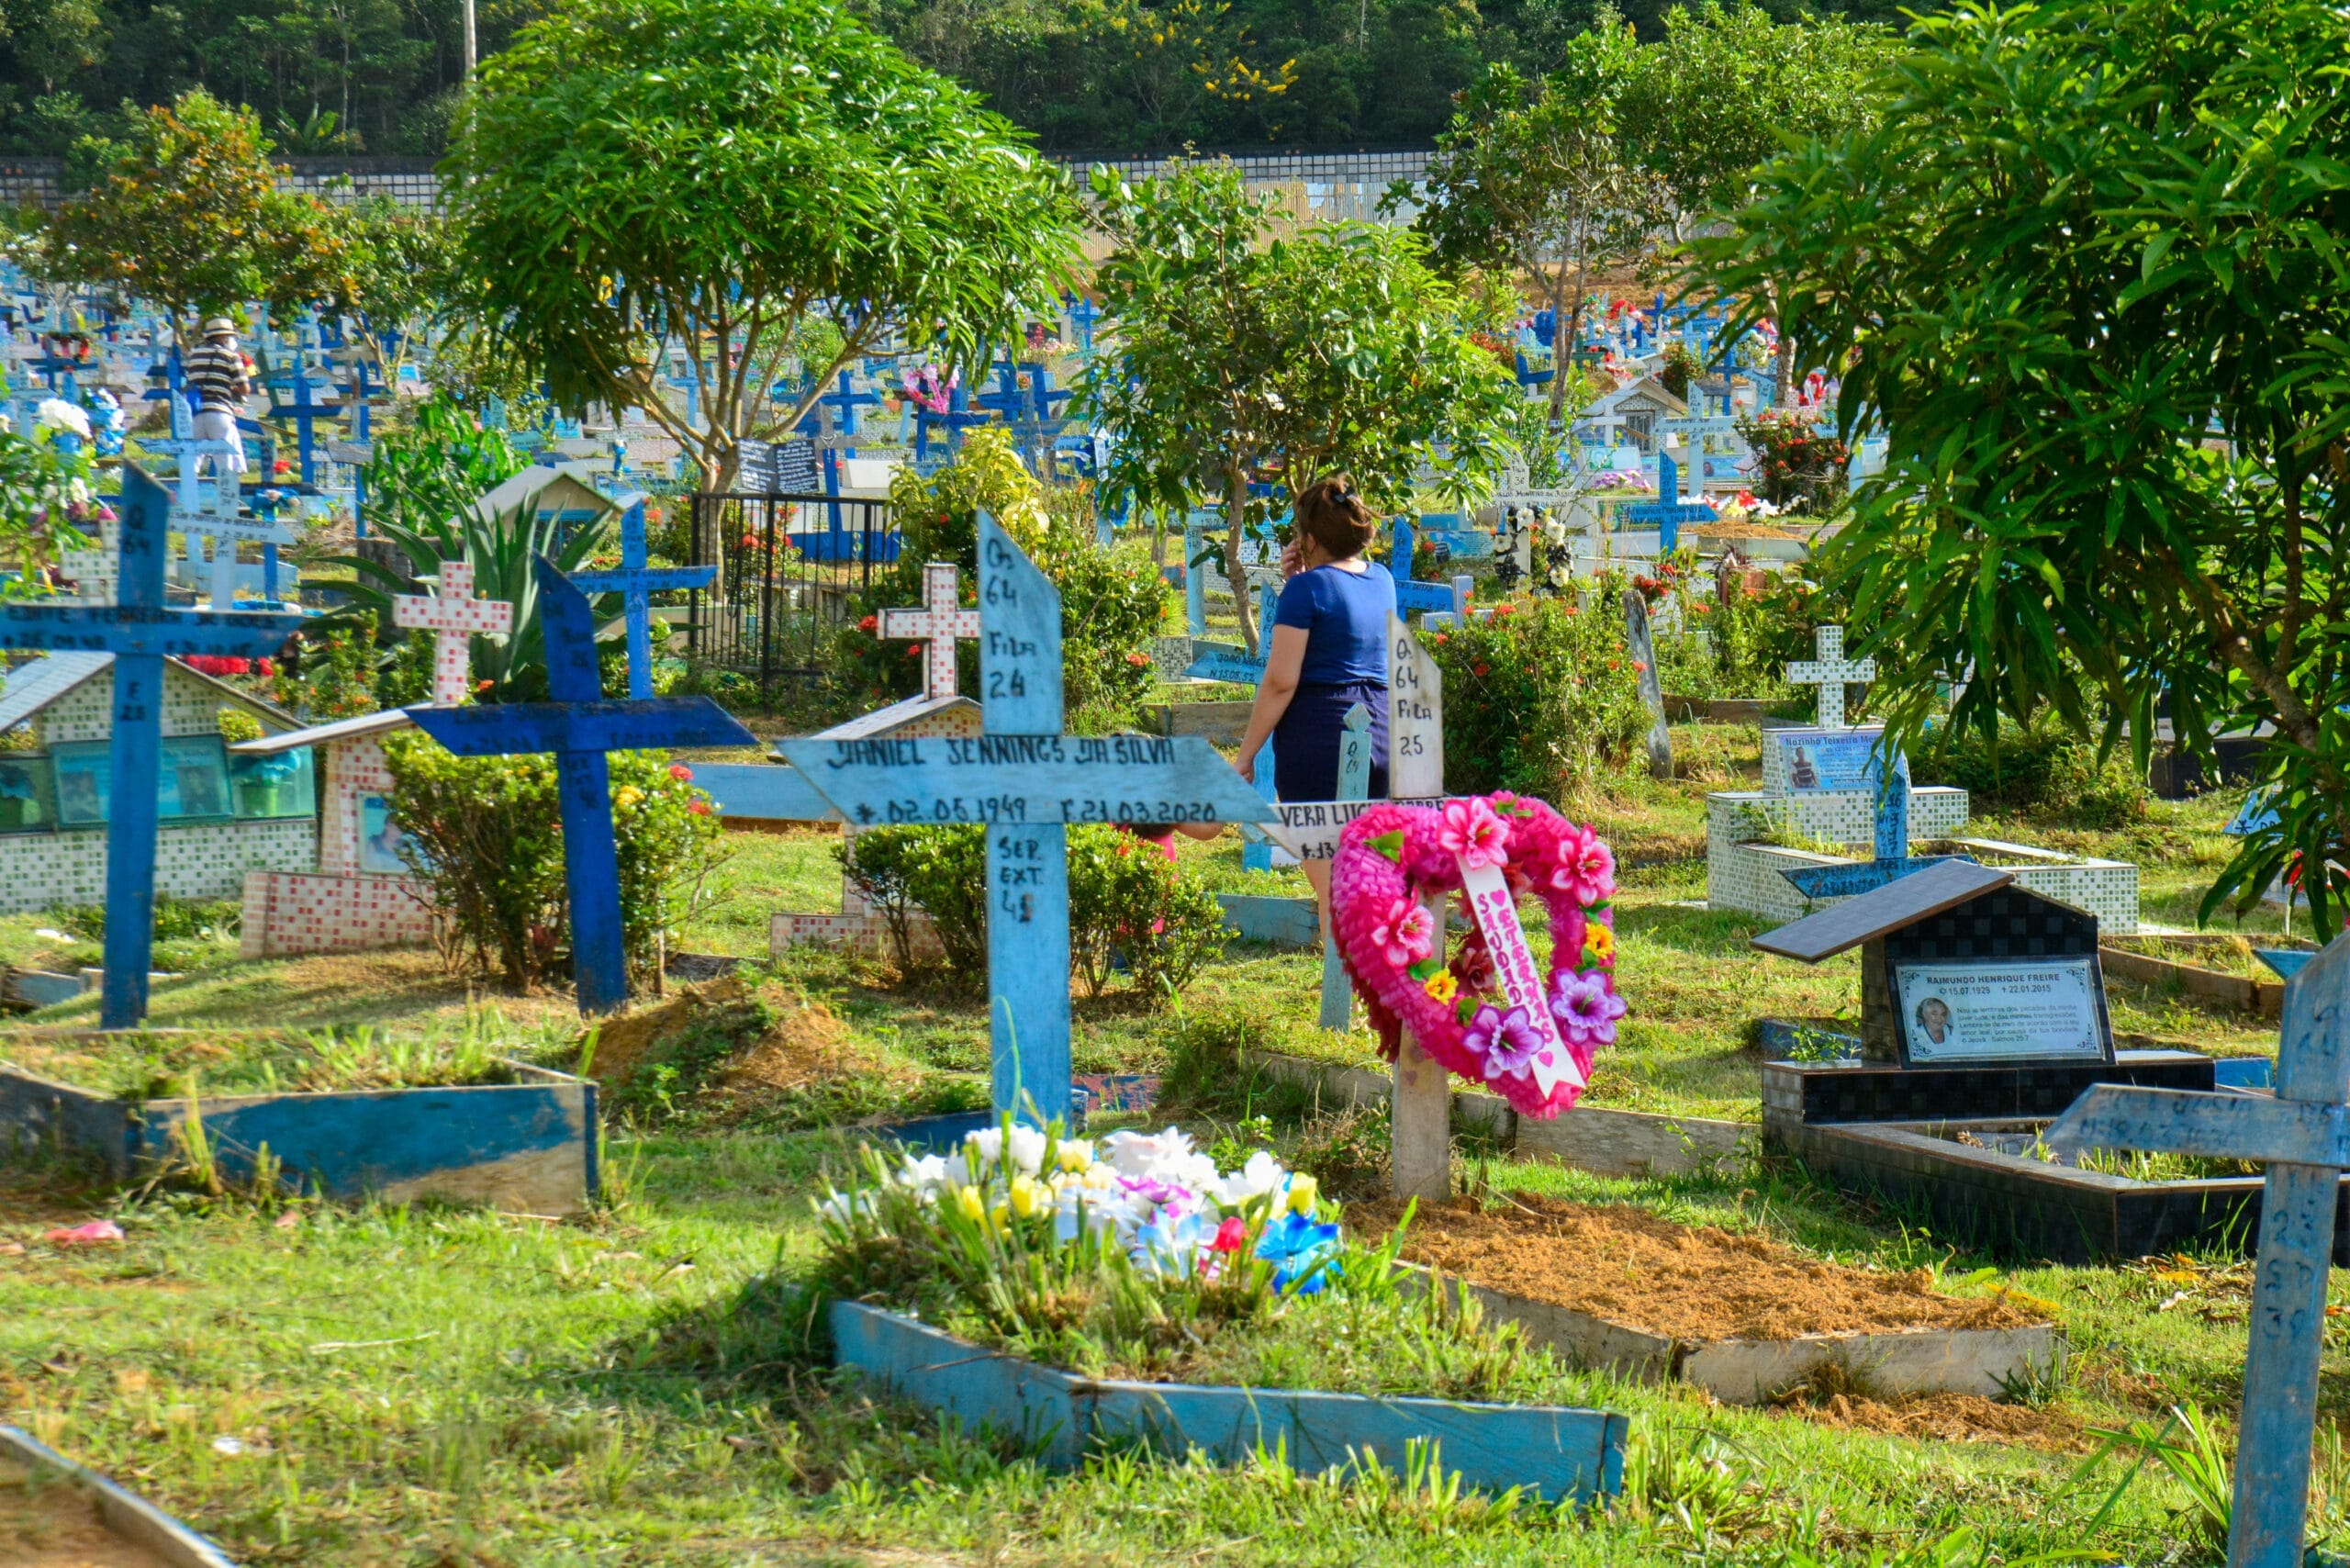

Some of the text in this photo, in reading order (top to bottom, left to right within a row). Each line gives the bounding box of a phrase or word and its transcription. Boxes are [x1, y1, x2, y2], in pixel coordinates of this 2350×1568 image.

[986, 575, 1017, 607] 64
[1395, 666, 1419, 689] 64
[1400, 734, 1425, 756] 25
[1823, 735, 1858, 745] Teixeira
[826, 738, 926, 769] DANIEL
[946, 737, 1066, 765] JENNINGS
[1115, 737, 1176, 766] SILVA
[1279, 805, 1326, 827] VERA
[1497, 907, 1555, 1045] ETERNAS
[1927, 973, 2061, 985] RAIMUNDO HENRIQUE FREIRE
